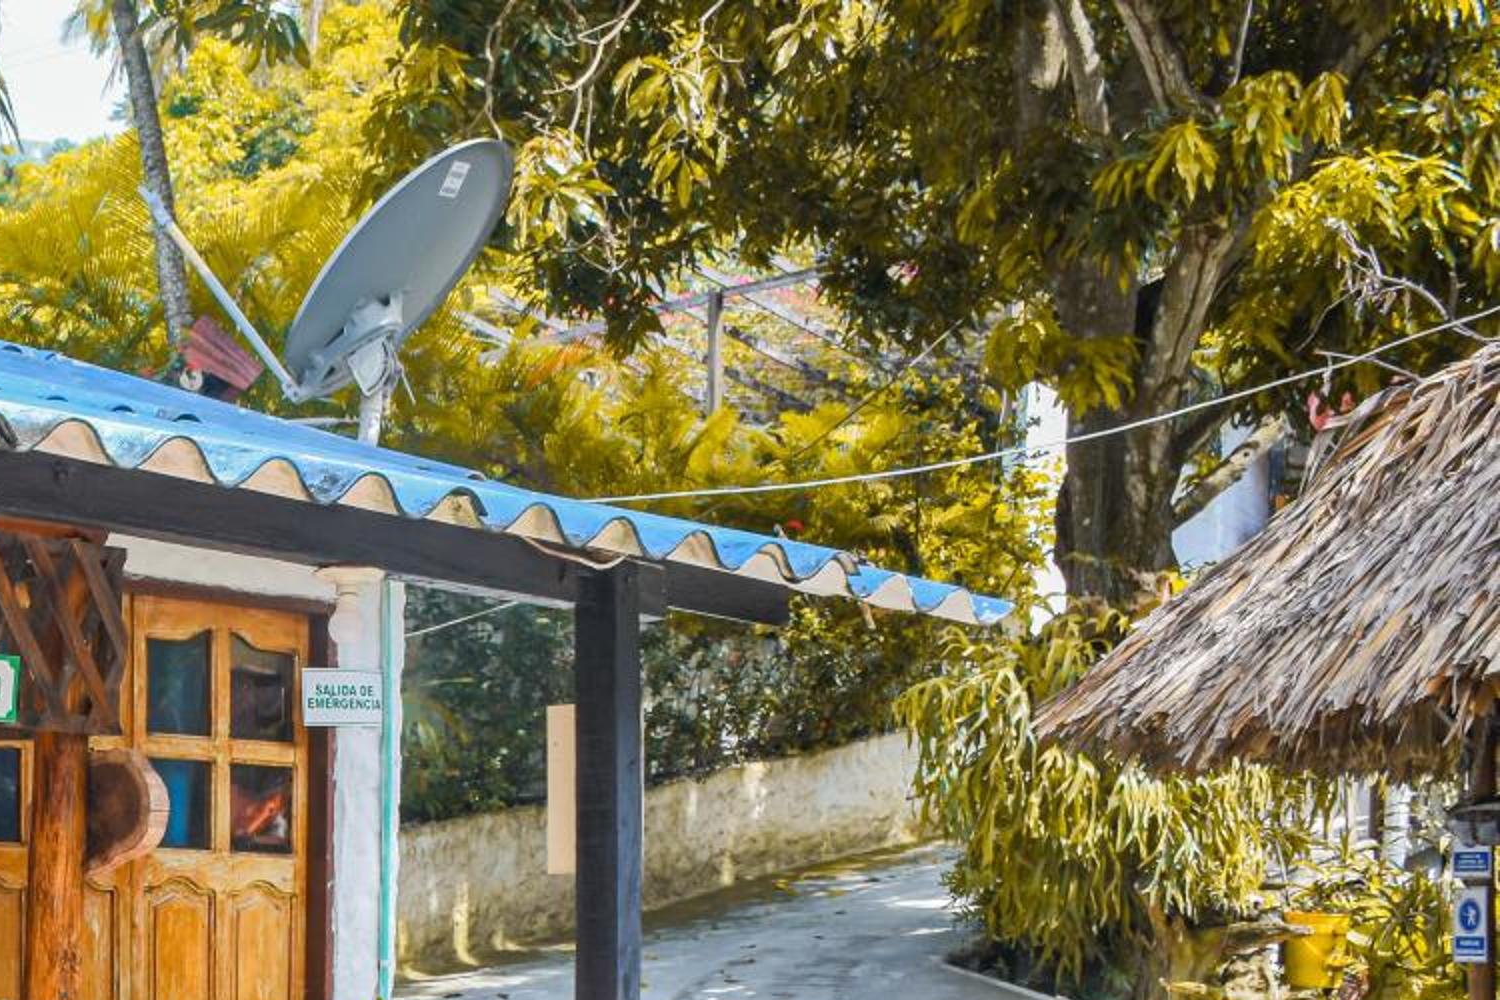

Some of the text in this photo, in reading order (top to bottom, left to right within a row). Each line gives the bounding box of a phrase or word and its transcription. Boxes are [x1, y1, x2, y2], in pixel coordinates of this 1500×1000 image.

[315, 684, 373, 697] SALIDA DE
[307, 697, 381, 710] EMERGENCIA
